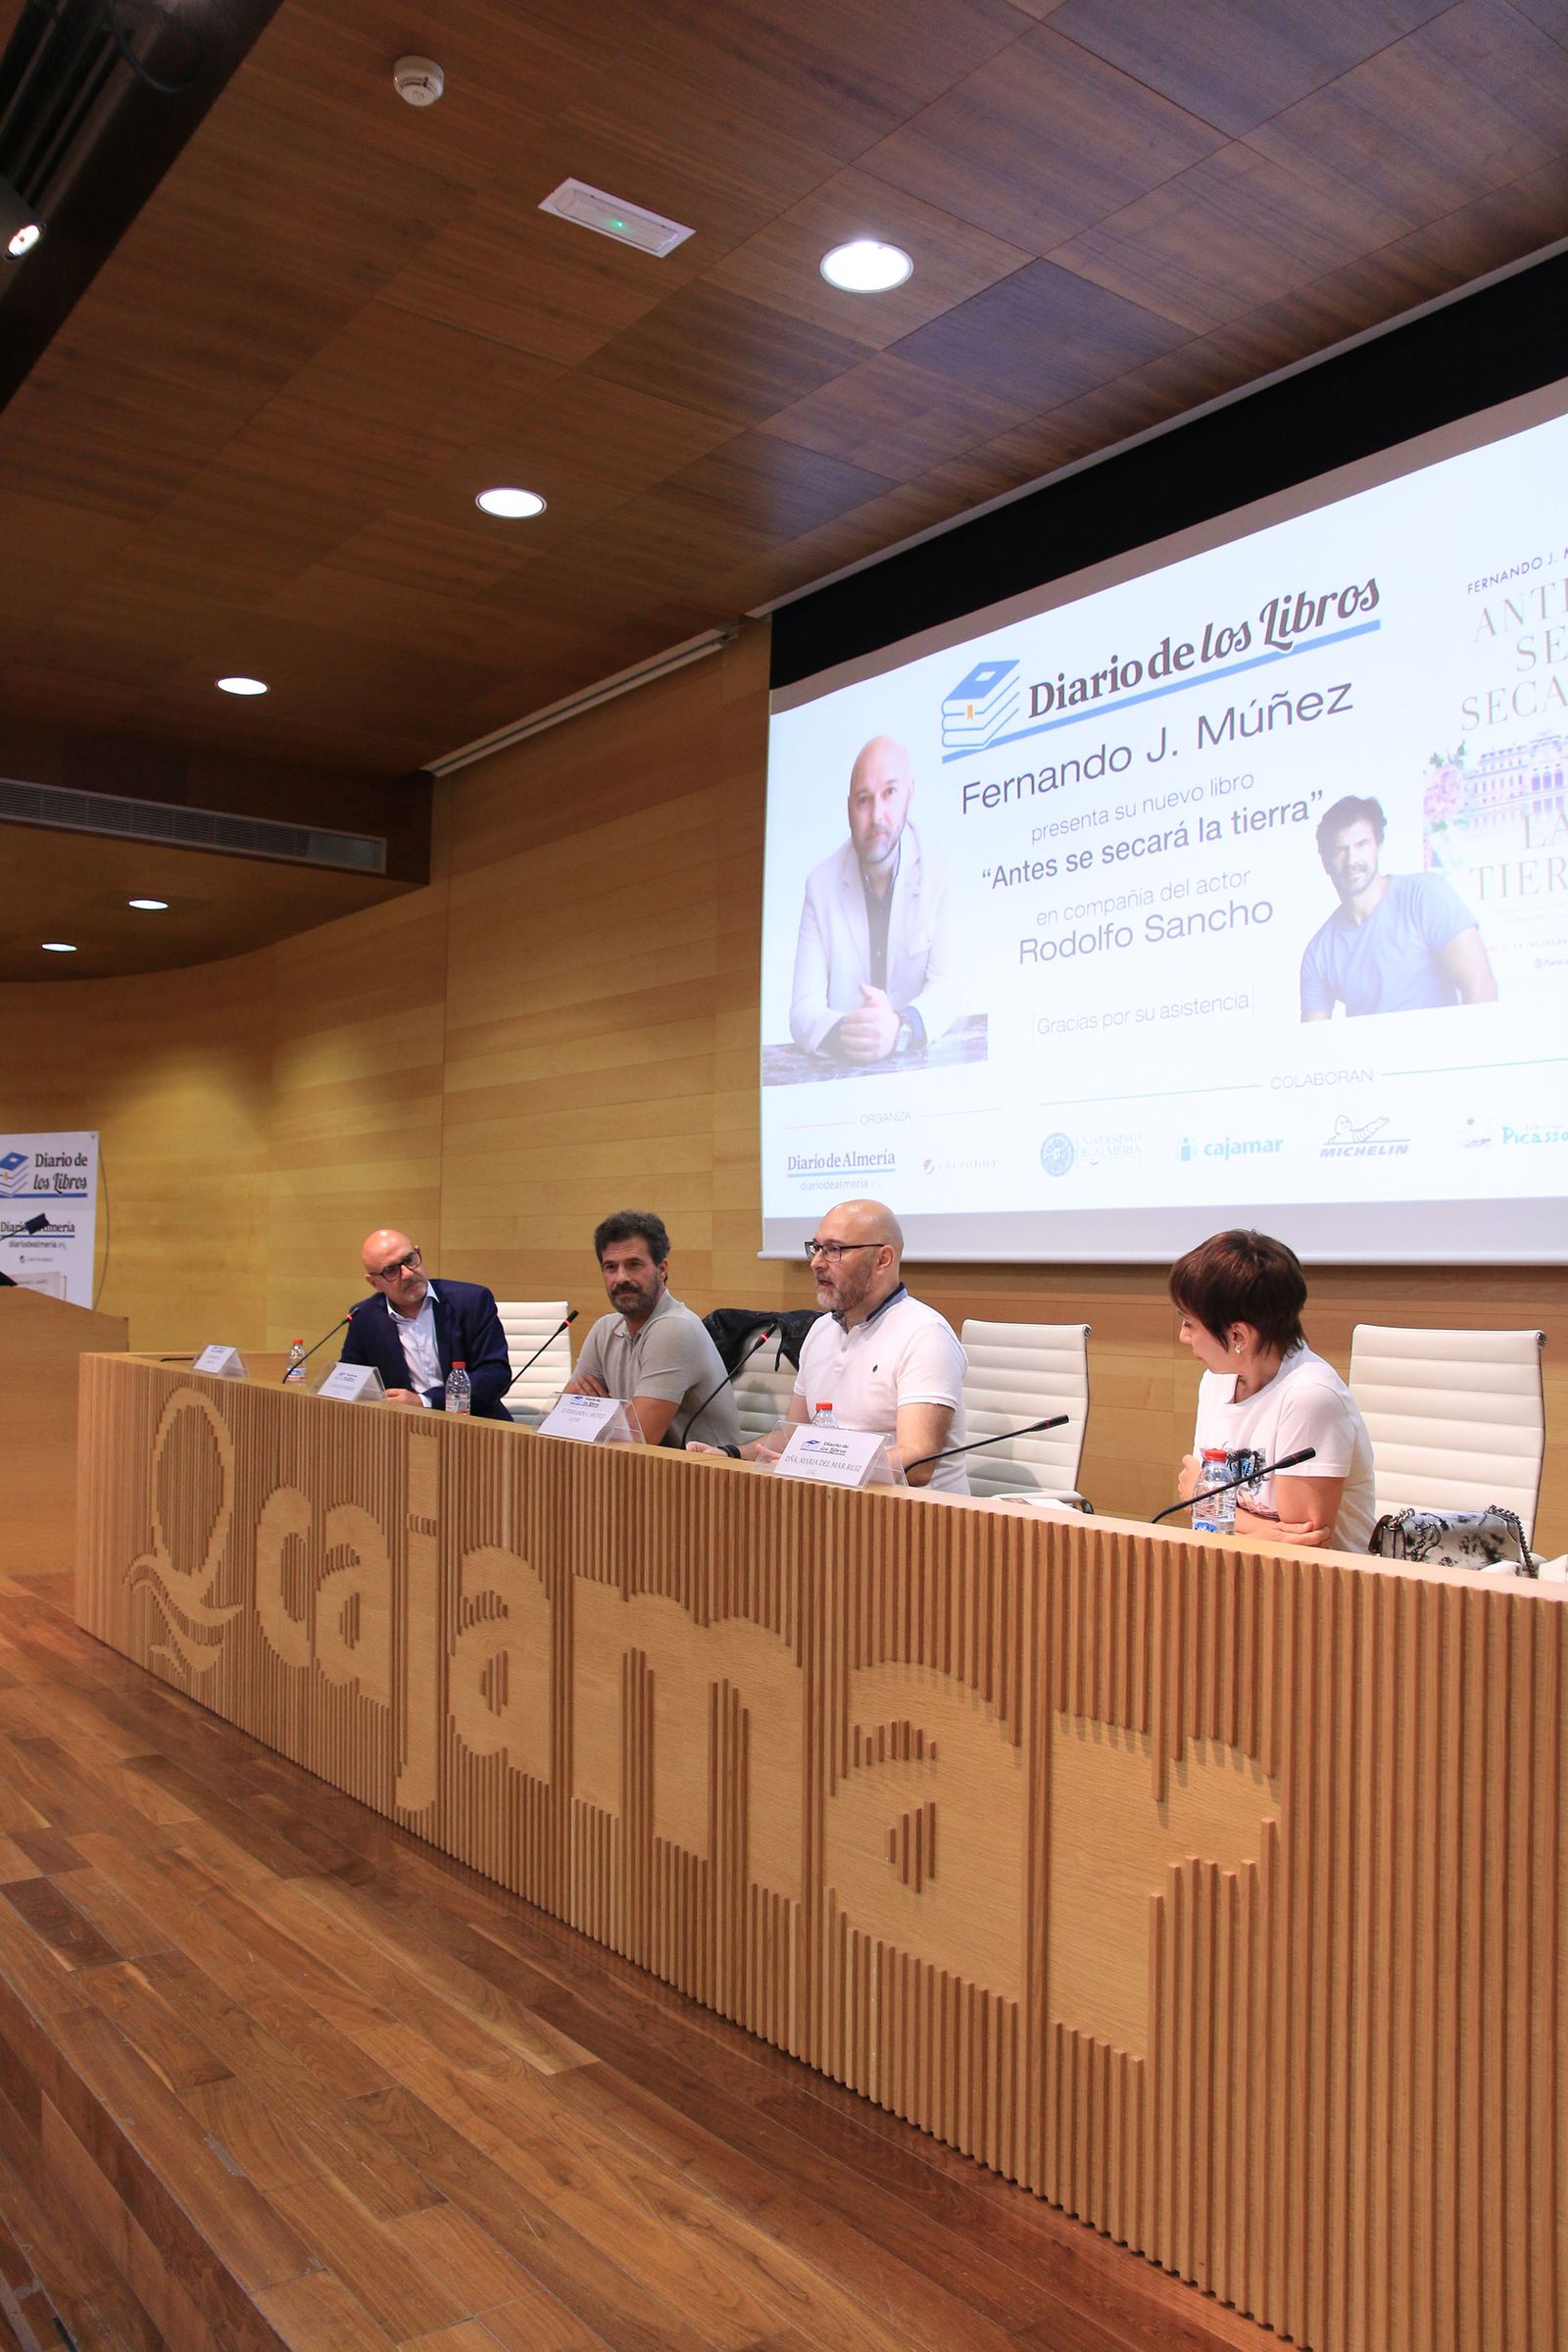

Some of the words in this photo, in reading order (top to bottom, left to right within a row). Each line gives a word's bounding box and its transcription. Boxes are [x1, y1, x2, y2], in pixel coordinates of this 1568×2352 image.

[1468, 558, 1543, 595] FERNANDO
[1028, 655, 1143, 719] Diario
[1147, 637, 1196, 680] de
[1200, 620, 1253, 664] los
[1258, 577, 1381, 652] Libros
[961, 743, 1133, 814] Fernando
[1147, 727, 1180, 763] J.
[1197, 681, 1355, 751] Múñez
[1031, 807, 1109, 845] presenta
[1114, 802, 1137, 822] su
[1143, 785, 1204, 815] nuevo
[1210, 771, 1255, 800] libro
[981, 855, 1059, 891] “Antes
[1065, 850, 1094, 873] se
[1101, 820, 1191, 868] secará
[1199, 813, 1222, 844] la
[1230, 788, 1325, 838] tierra”
[1036, 907, 1059, 926] en
[1160, 876, 1190, 903] del
[1196, 867, 1251, 896] actor
[1019, 913, 1134, 965] Rodolfo
[1145, 896, 1274, 946] Sancho
[1037, 1016, 1099, 1035] Gracias
[1102, 1010, 1131, 1031] por
[1135, 1007, 1155, 1022] su
[1159, 992, 1250, 1020] asistencia
[1270, 1069, 1374, 1091] COLABORAN
[859, 1110, 912, 1126] ORGANIZA
[1501, 1126, 1568, 1146] Picasso
[35, 1152, 73, 1167] Diario
[74, 1152, 88, 1167] de
[787, 1153, 825, 1172] Diario
[826, 1152, 841, 1168] de
[842, 1148, 896, 1168] Almería
[1203, 1137, 1285, 1161] cajamar
[1319, 1144, 1409, 1158] MICHELIN
[33, 1174, 50, 1190] los
[54, 1172, 87, 1195] Libros
[255, 1429, 1282, 2063] cajamar
